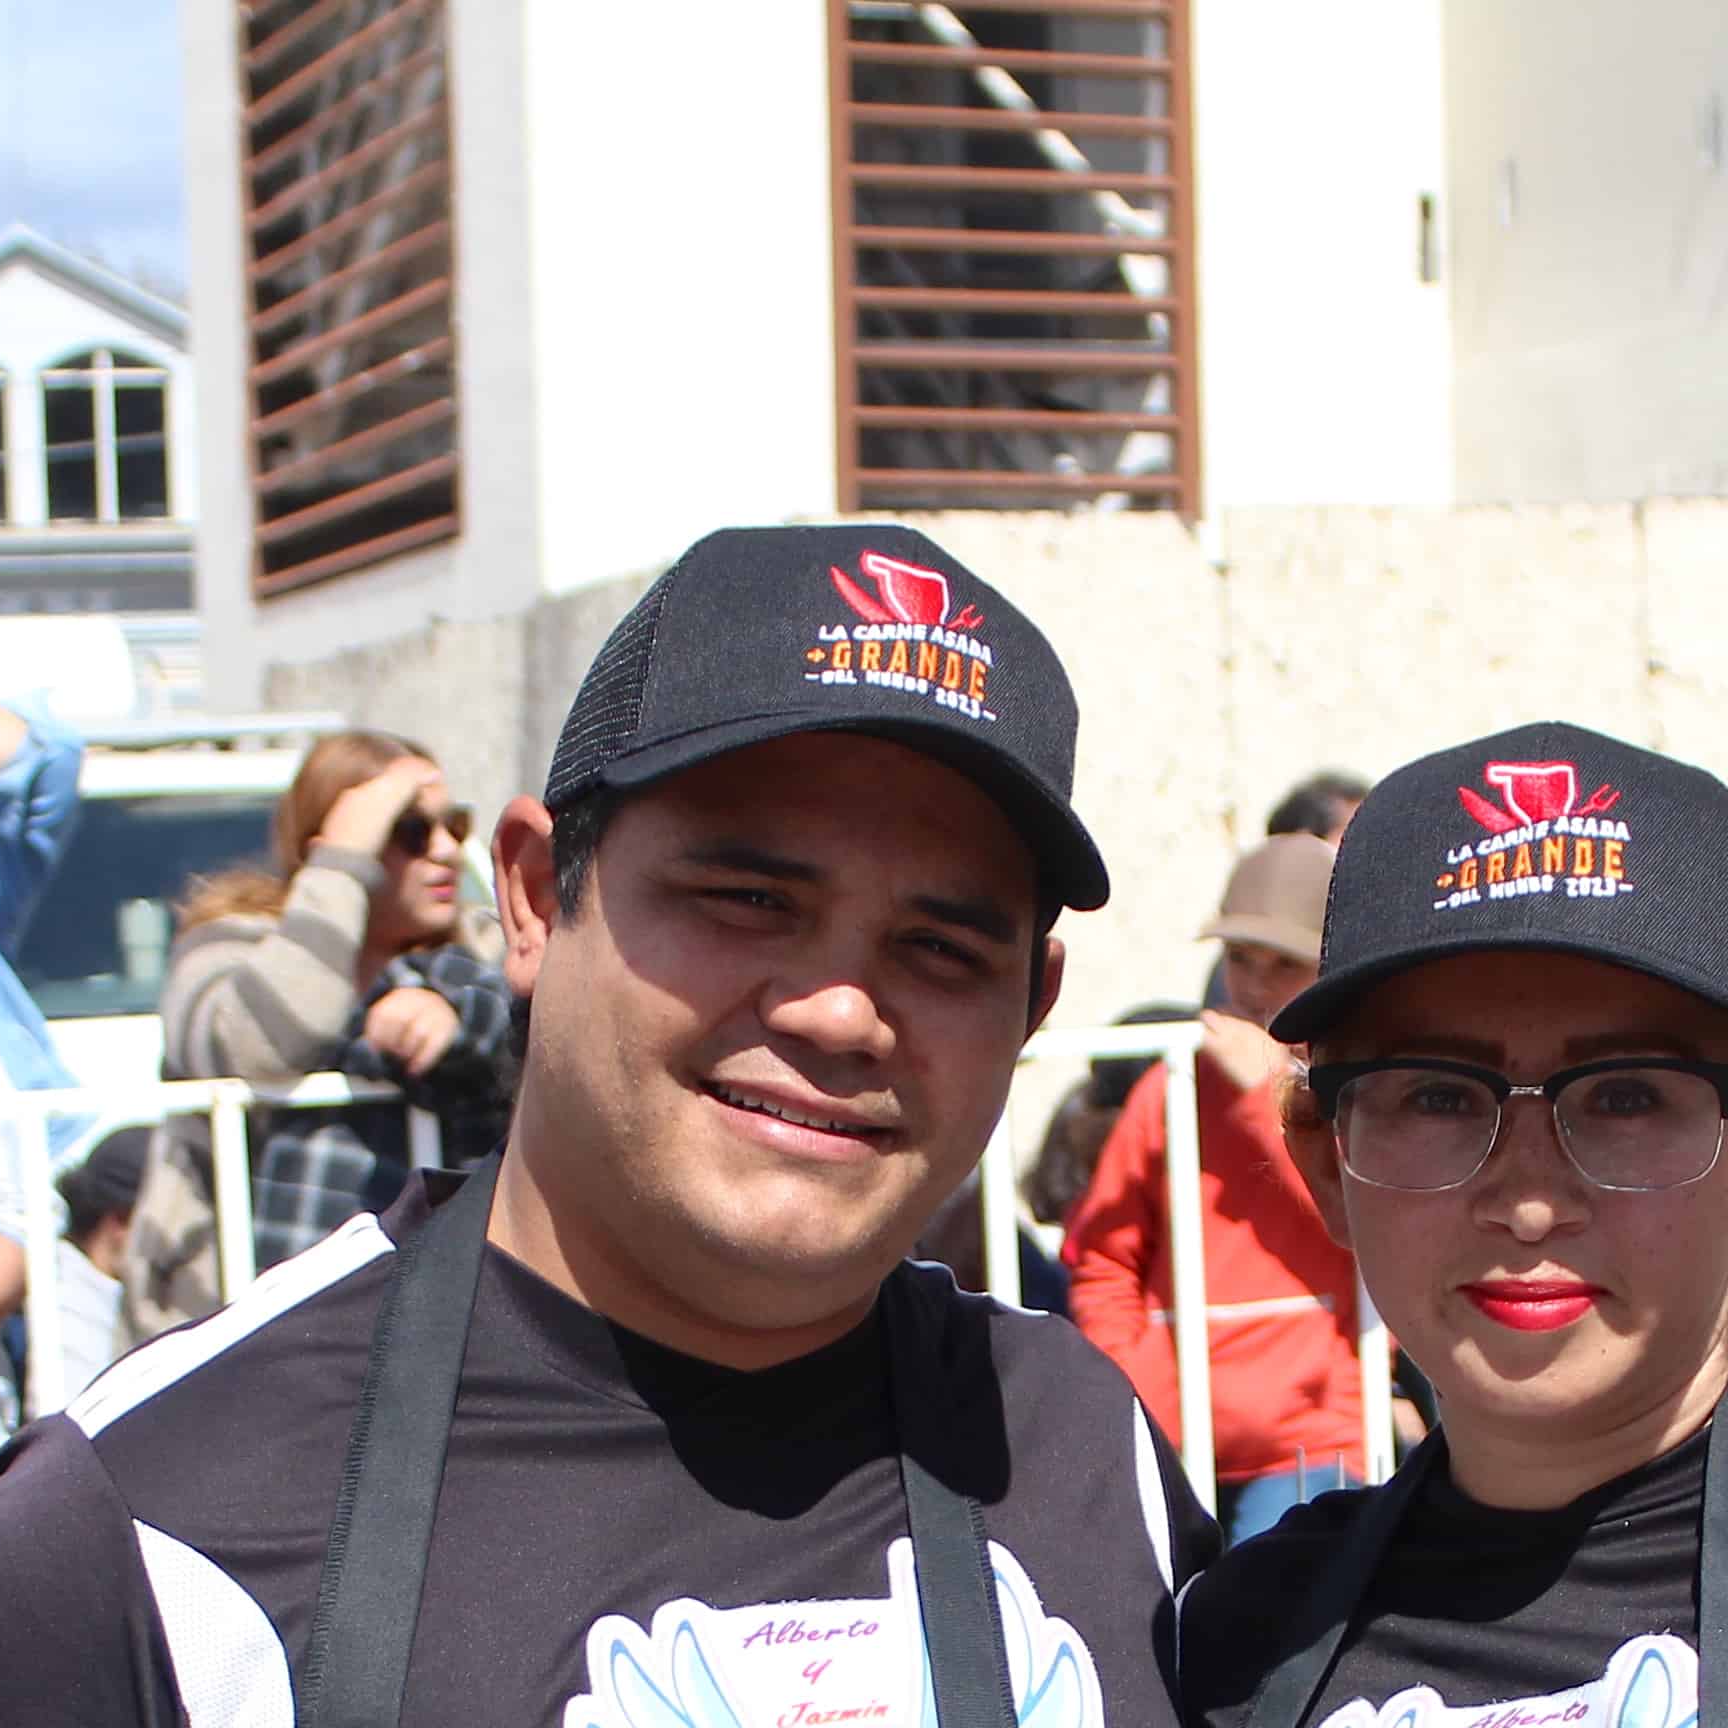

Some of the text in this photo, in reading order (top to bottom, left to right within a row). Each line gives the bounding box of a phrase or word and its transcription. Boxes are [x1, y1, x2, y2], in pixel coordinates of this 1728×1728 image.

[818, 622, 993, 668] LA CARNE ASADA
[1447, 815, 1632, 865] LA CARNE ASADA
[742, 1618, 880, 1649] Alberto
